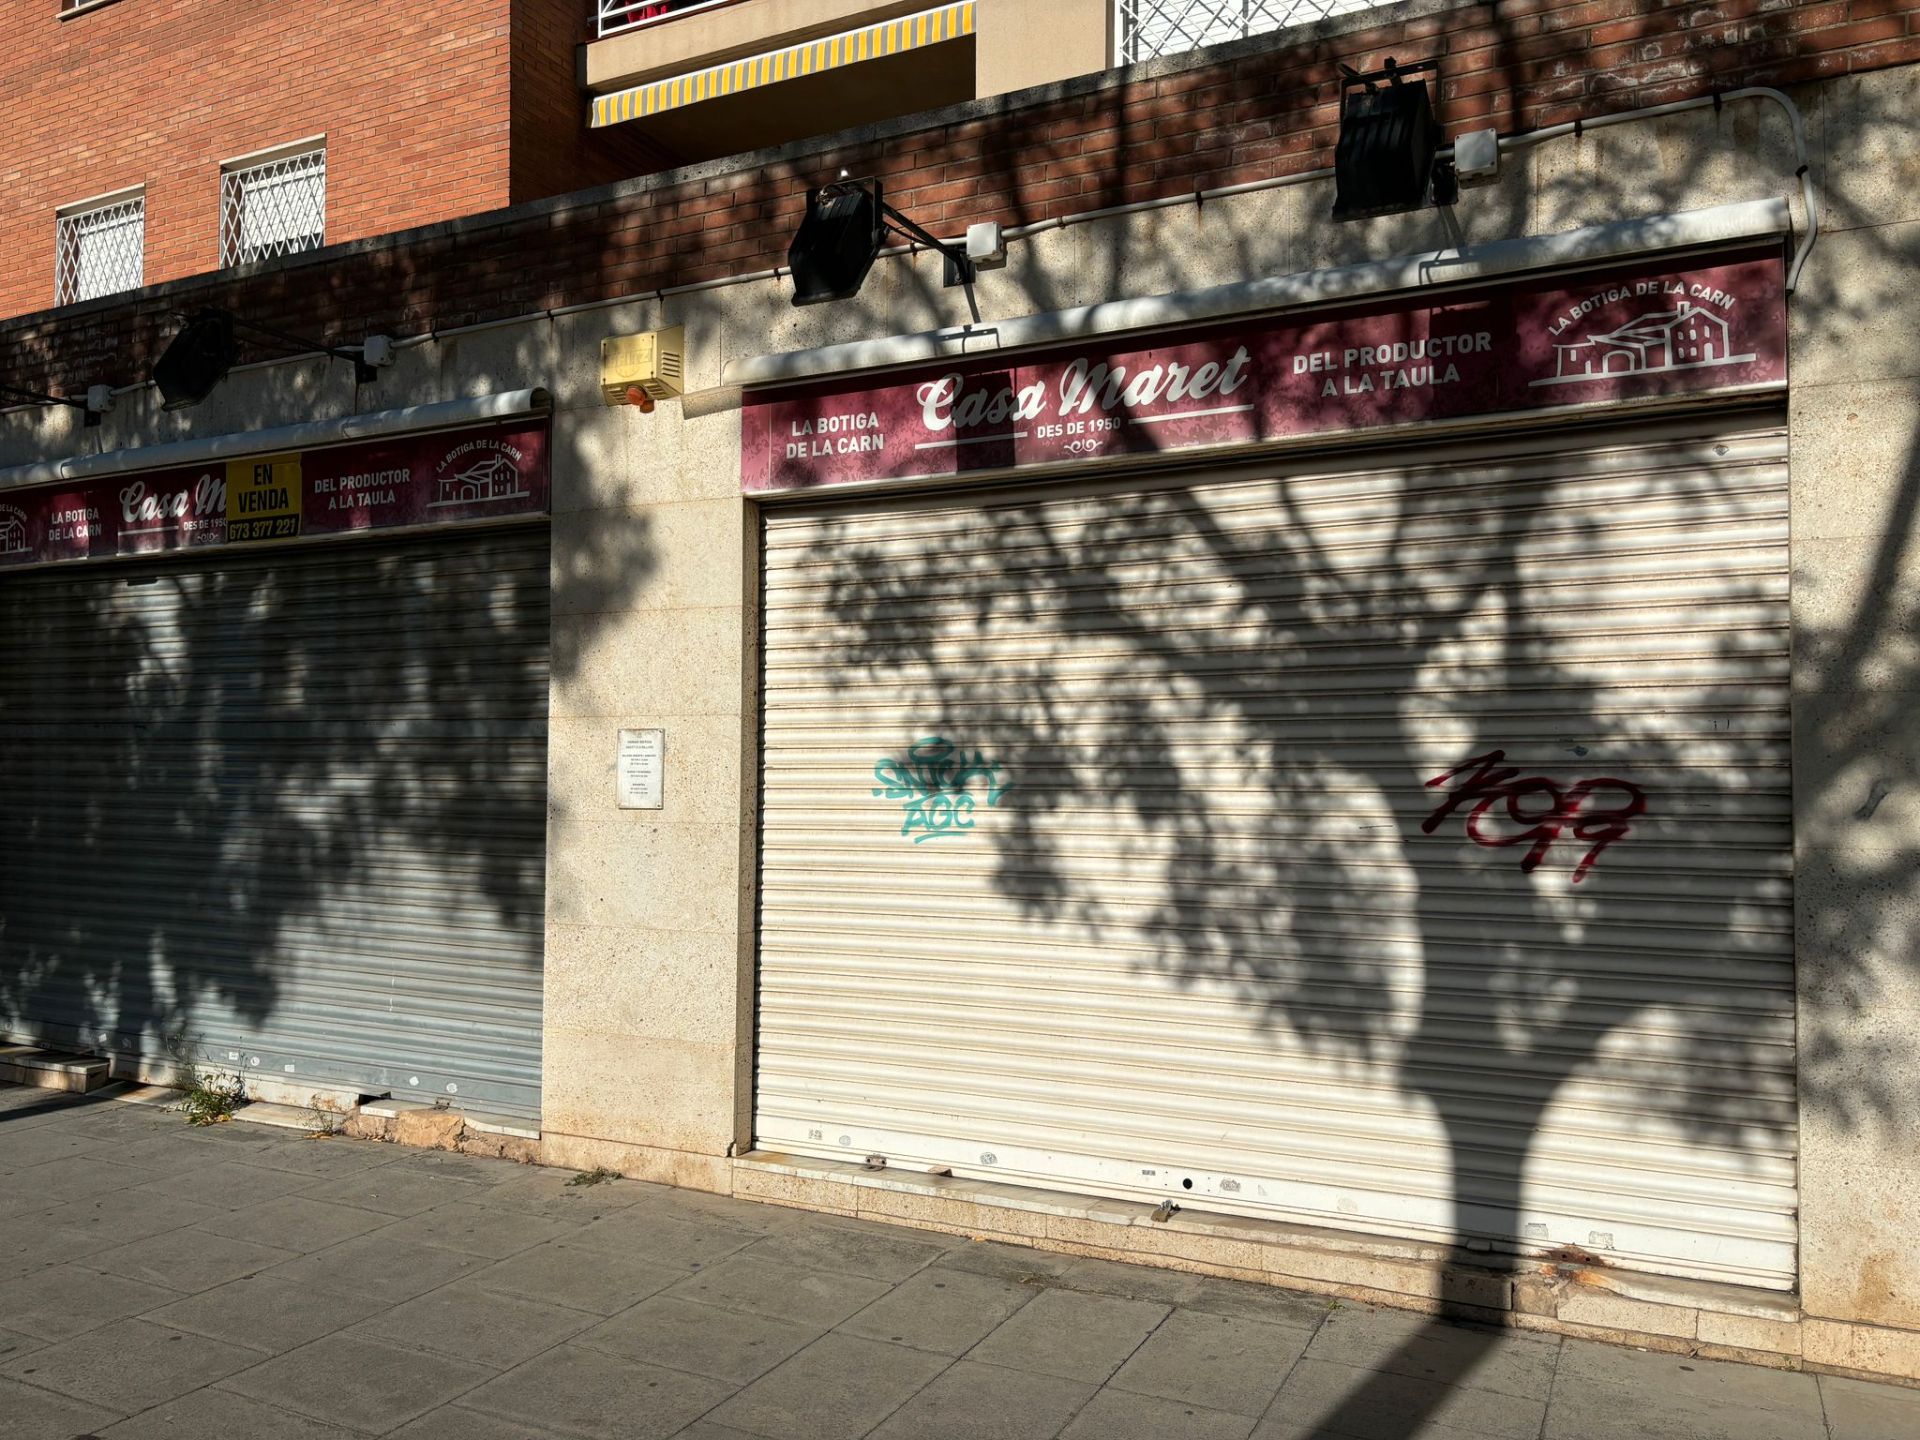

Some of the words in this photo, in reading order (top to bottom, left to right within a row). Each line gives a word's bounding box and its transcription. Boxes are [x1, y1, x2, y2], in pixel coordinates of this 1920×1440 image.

[1548, 315, 1571, 336] LA
[1569, 286, 1631, 320] BOTIGA
[1636, 281, 1658, 296] DE
[1663, 280, 1685, 295] LA
[1690, 283, 1736, 311] CARN
[1293, 351, 1338, 375] DEL
[1344, 331, 1492, 368] PRODUCTOR
[916, 372, 1047, 431] Casa
[1058, 345, 1251, 417] Maret
[1321, 378, 1337, 397] A
[1344, 373, 1374, 395] LA
[1380, 363, 1461, 390] TAULA
[791, 419, 812, 437] LA
[817, 412, 879, 434] BOTIGA
[1037, 424, 1063, 439] DES
[1066, 421, 1084, 435] DE
[1088, 417, 1121, 433] 1950
[436, 460, 447, 473] LA
[446, 441, 475, 463] BOTIGA
[476, 439, 487, 449] DE
[489, 439, 499, 449] LA
[500, 442, 522, 461] CARN
[786, 442, 807, 460] DE
[812, 440, 833, 457] LA
[837, 433, 884, 454] CARN
[253, 463, 273, 486] EN
[314, 478, 337, 494] DEL
[339, 468, 410, 491] PRODUCTOR
[119, 480, 188, 523] Casa
[238, 487, 289, 513] VENDA
[328, 496, 337, 511] A
[339, 495, 354, 509] LA
[357, 489, 396, 506] TAULA
[52, 511, 63, 524] LA
[66, 507, 99, 523] BOTIGA
[183, 520, 198, 531] DES
[199, 519, 209, 529] DE
[49, 529, 60, 541] DE
[63, 527, 74, 539] LA
[77, 523, 101, 537] CARN
[229, 522, 250, 540] 673
[252, 520, 272, 538] 377
[276, 518, 296, 534] 221
